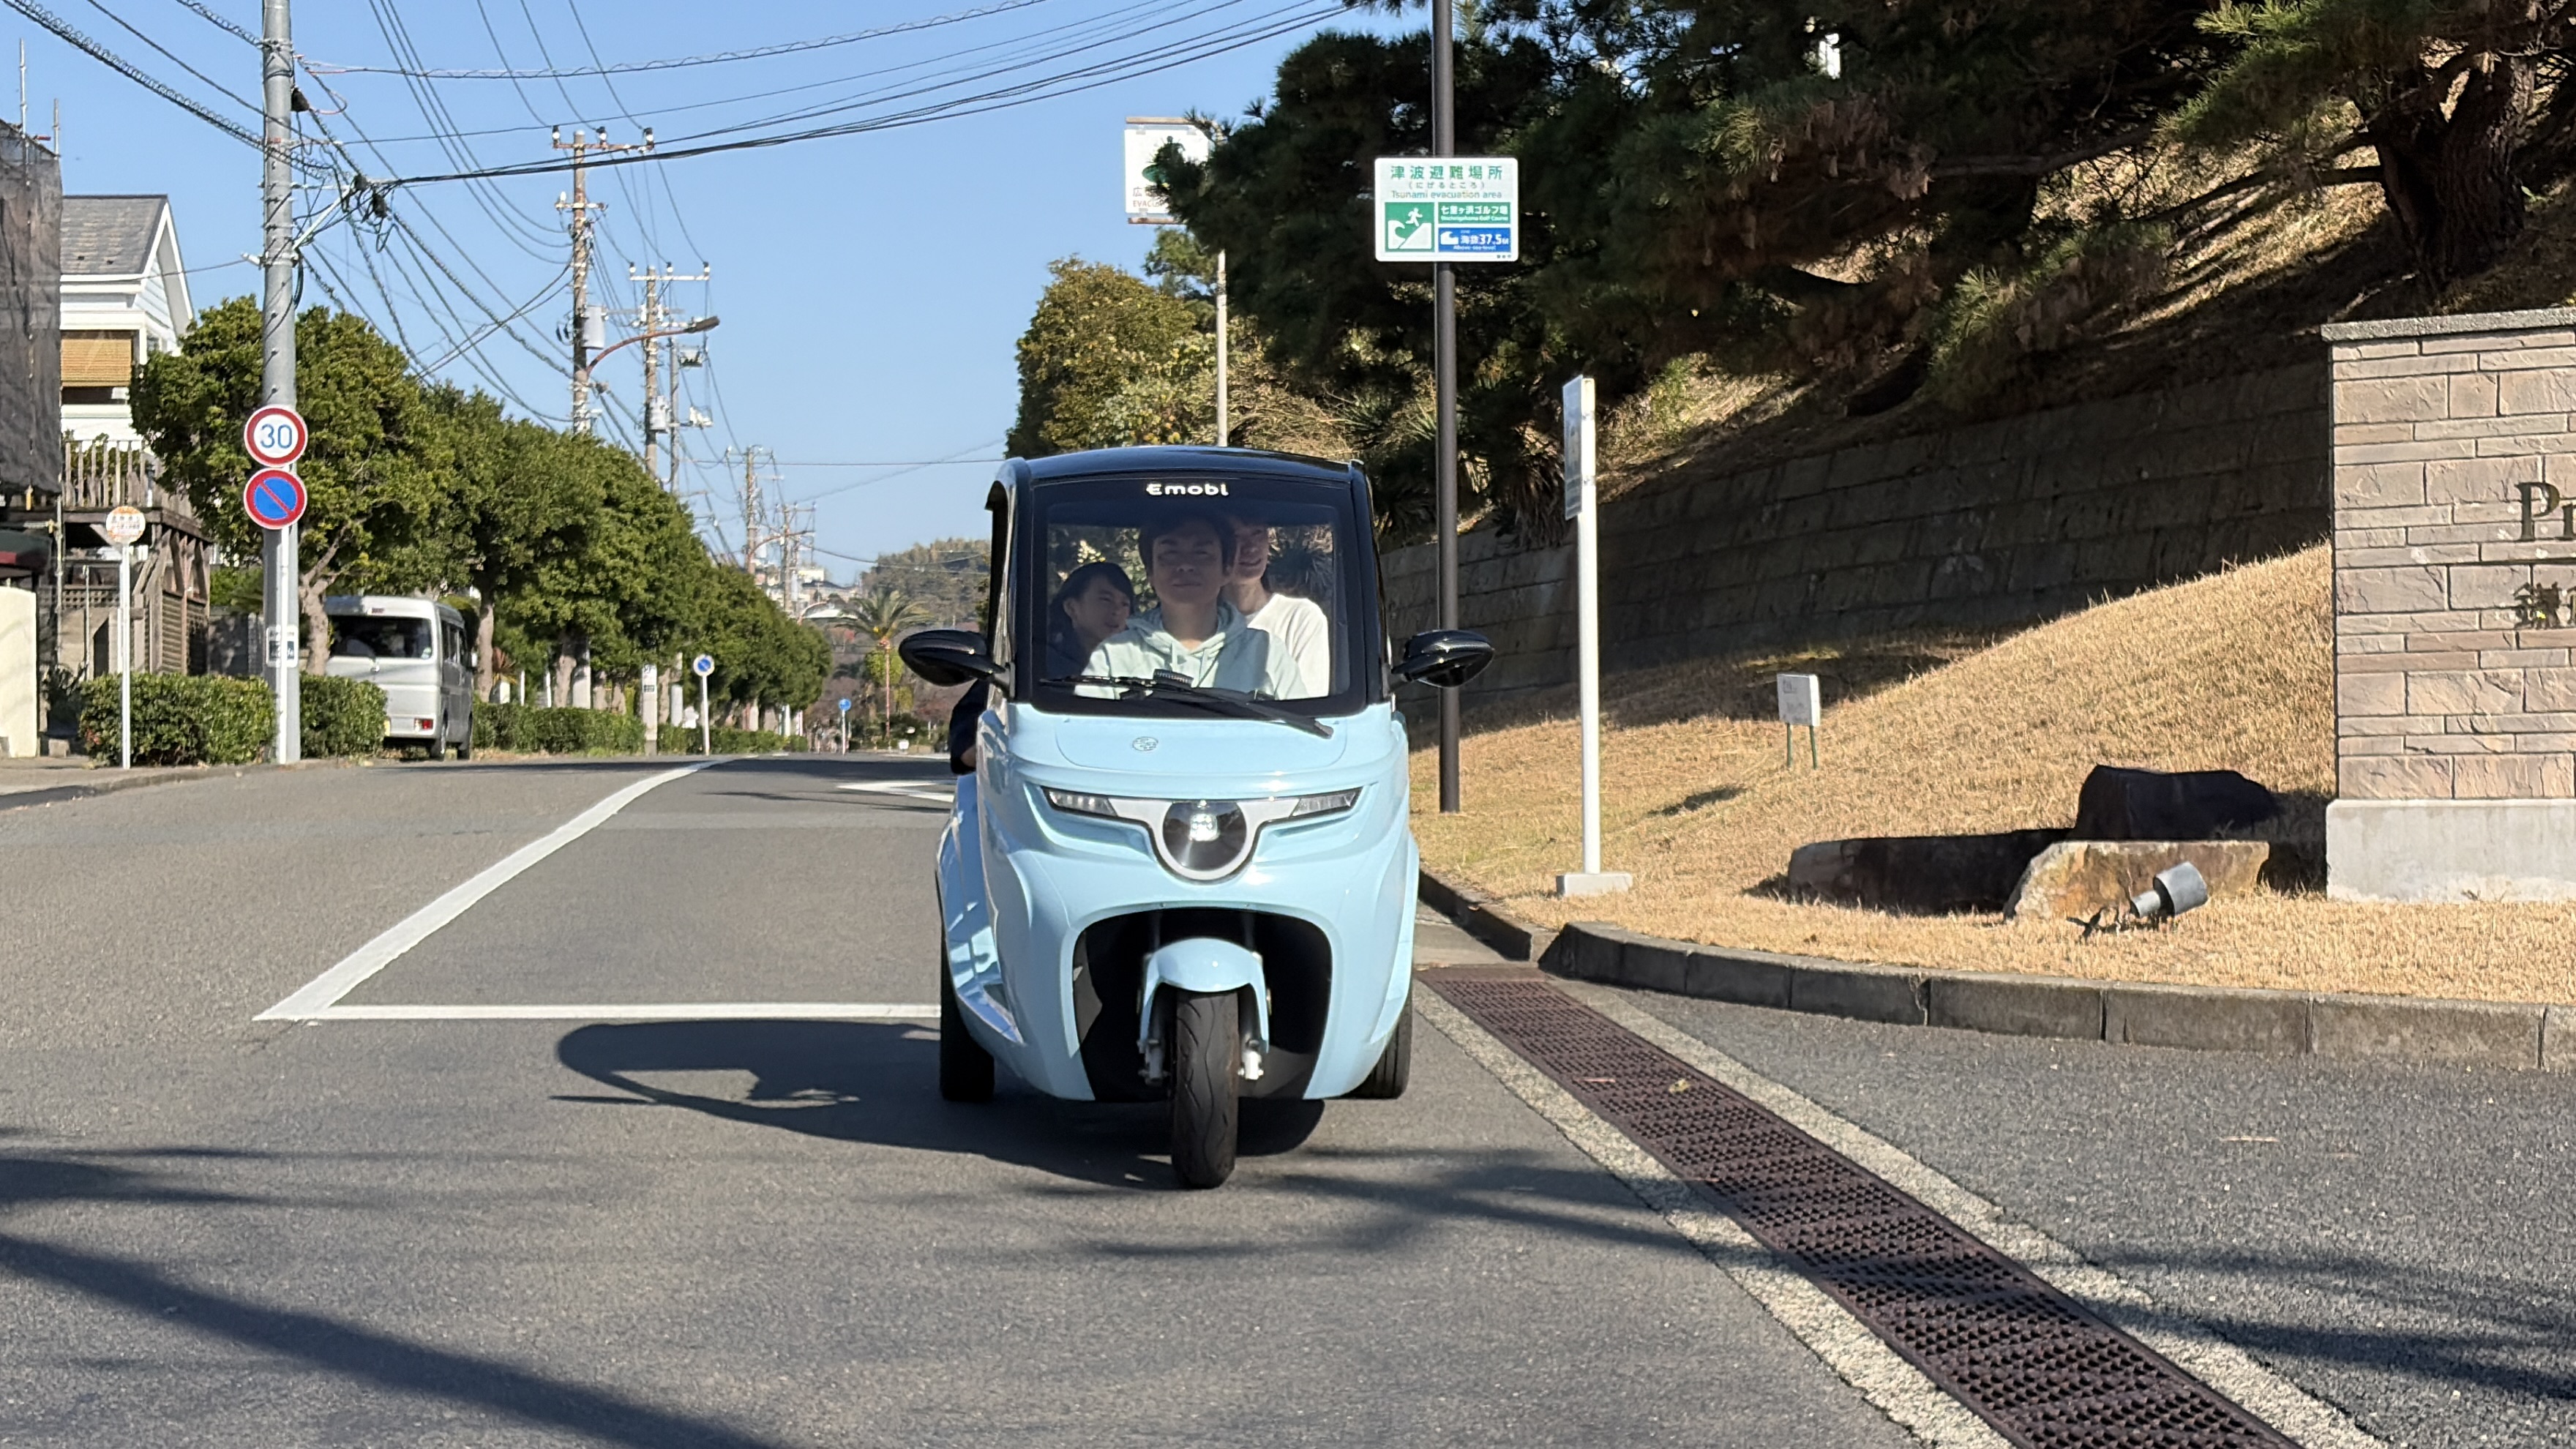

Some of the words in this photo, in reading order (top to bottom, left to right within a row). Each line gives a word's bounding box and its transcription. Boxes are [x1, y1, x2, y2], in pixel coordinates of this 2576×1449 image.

[1390, 165, 1502, 180] 津波避難場所
[1392, 190, 1428, 198] Tsunami
[261, 424, 292, 449] 30
